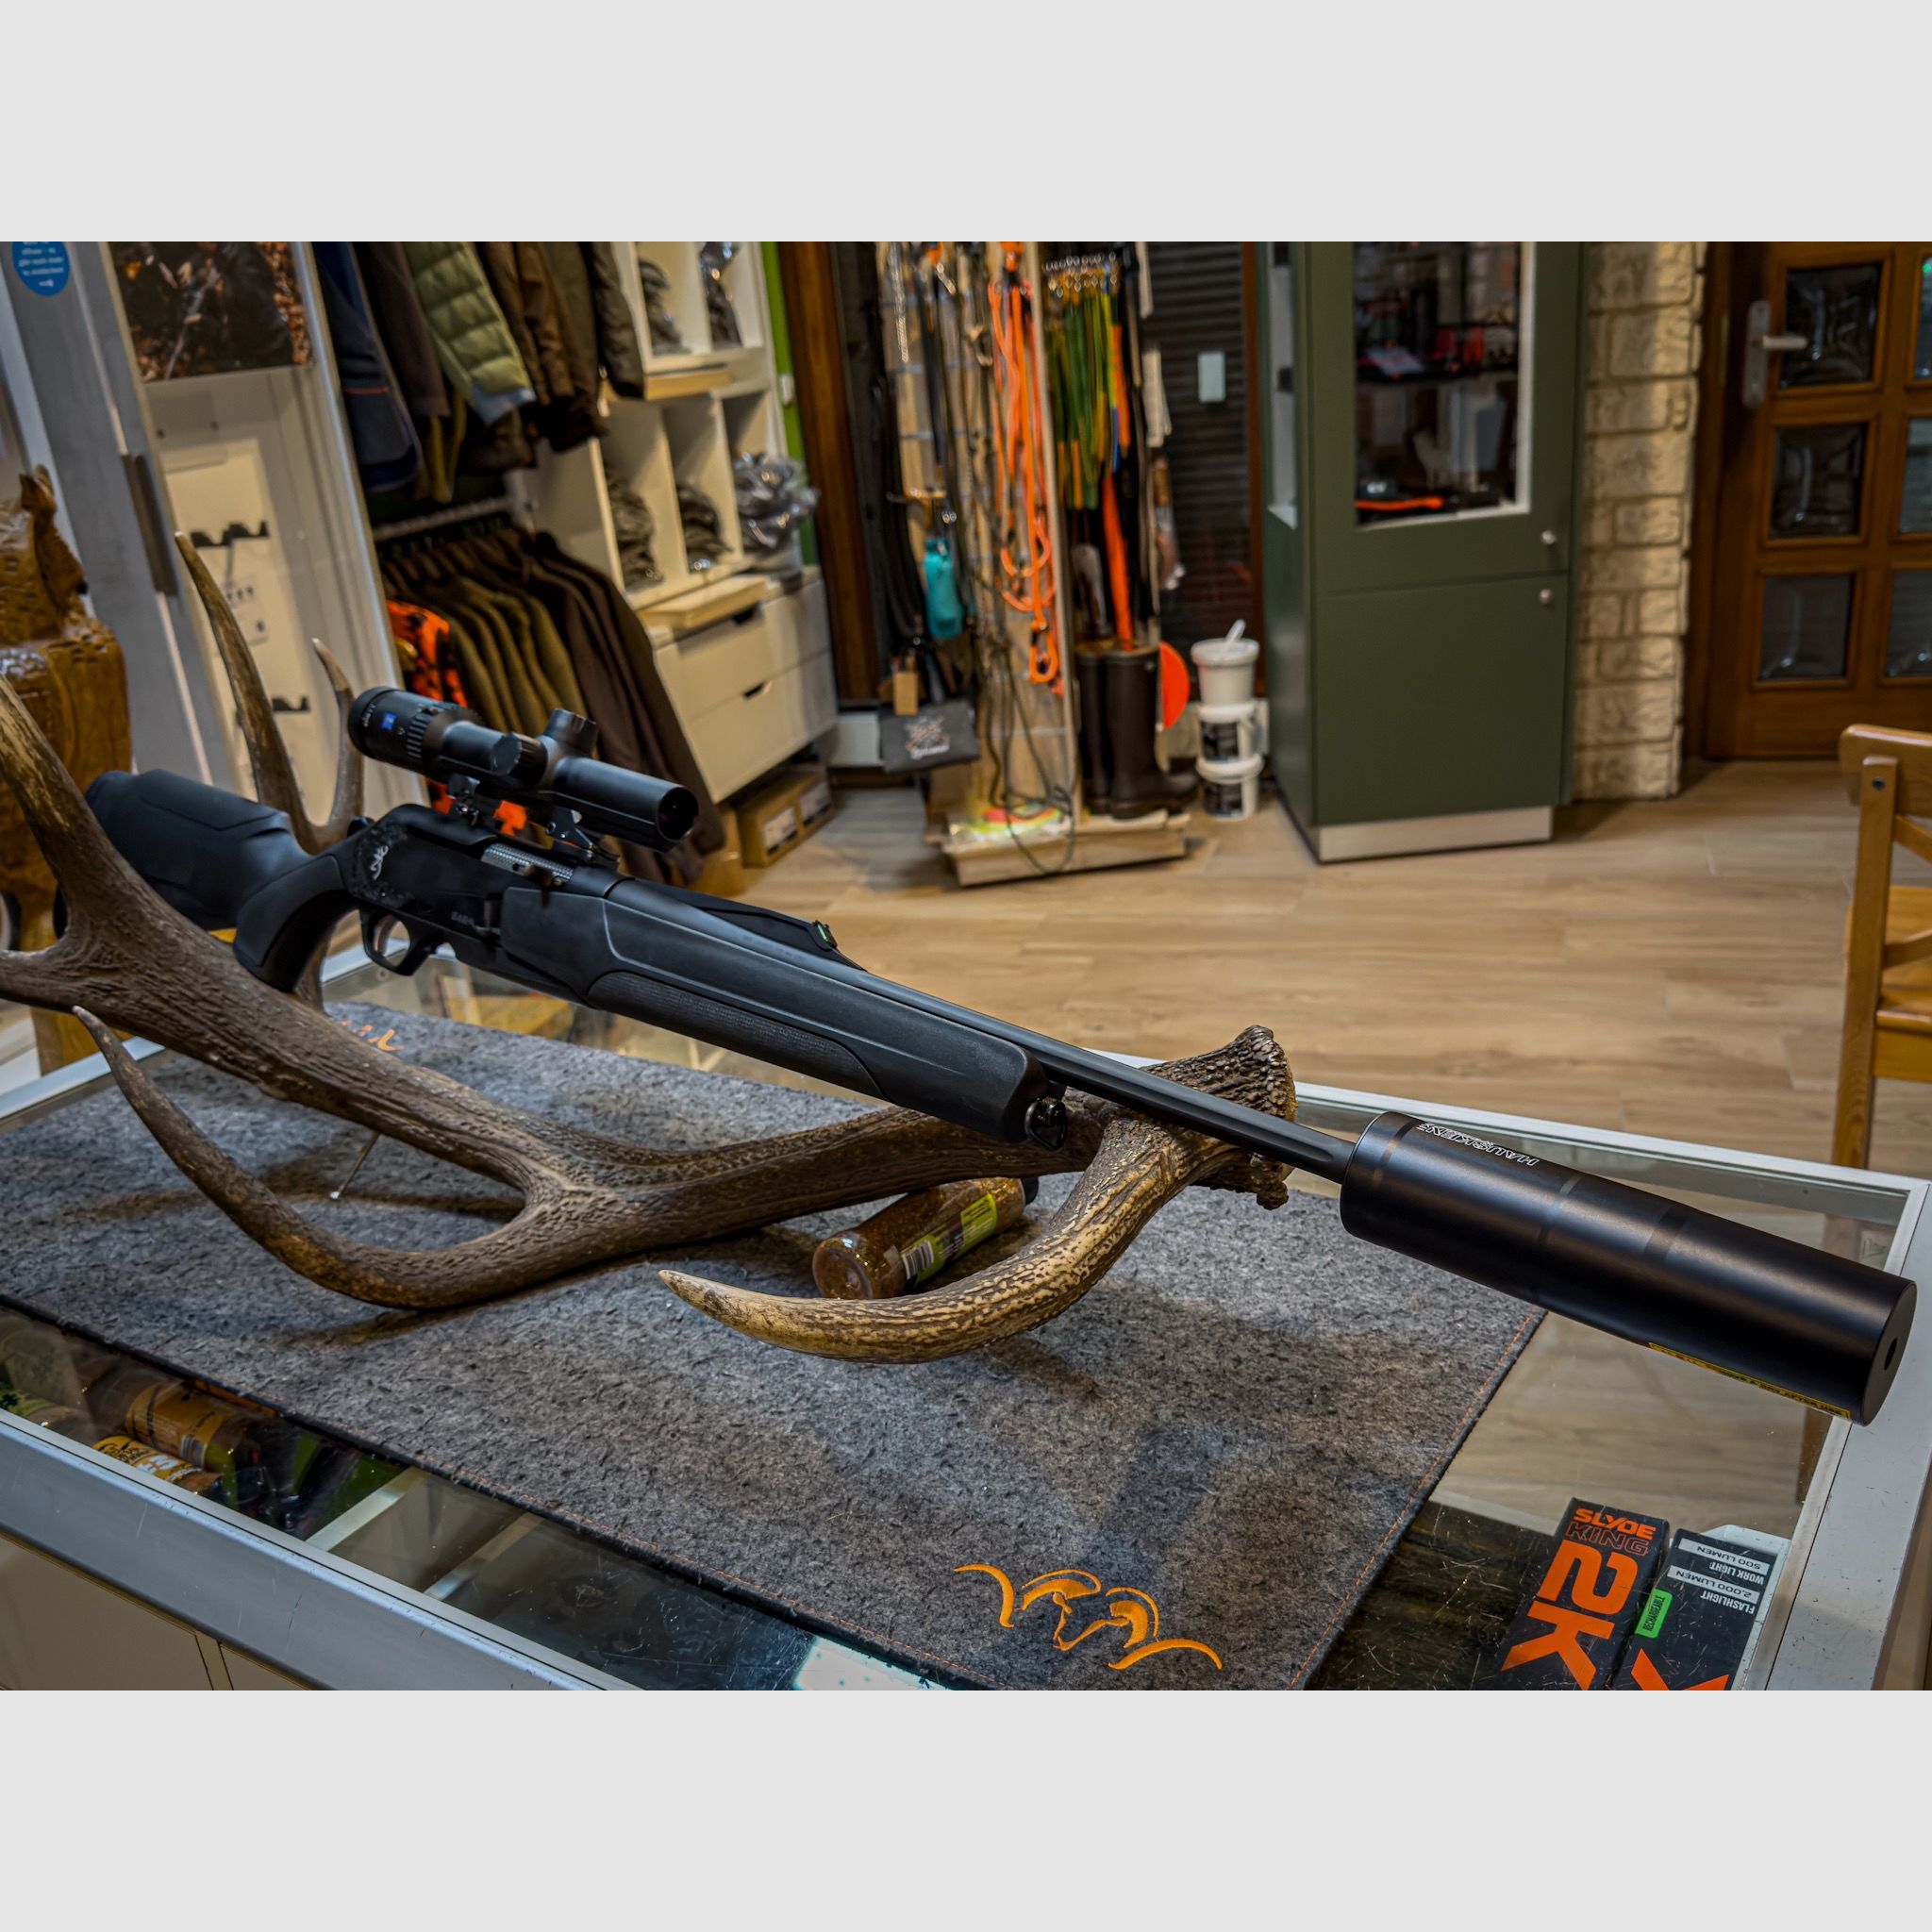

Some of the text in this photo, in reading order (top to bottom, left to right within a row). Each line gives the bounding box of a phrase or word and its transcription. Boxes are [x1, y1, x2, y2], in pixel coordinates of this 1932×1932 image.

[1574, 1508, 1657, 1541] SLYDE
[1566, 1521, 1650, 1557] KING
[1697, 1545, 1761, 1570] 500 LUMEN
[1676, 1570, 1752, 1598] 2,000 LUMEN
[1709, 1561, 1765, 1586] WORK LIGHT
[1502, 1540, 1639, 1690] 2K
[1700, 1590, 1755, 1615] FLASHLIGHT
